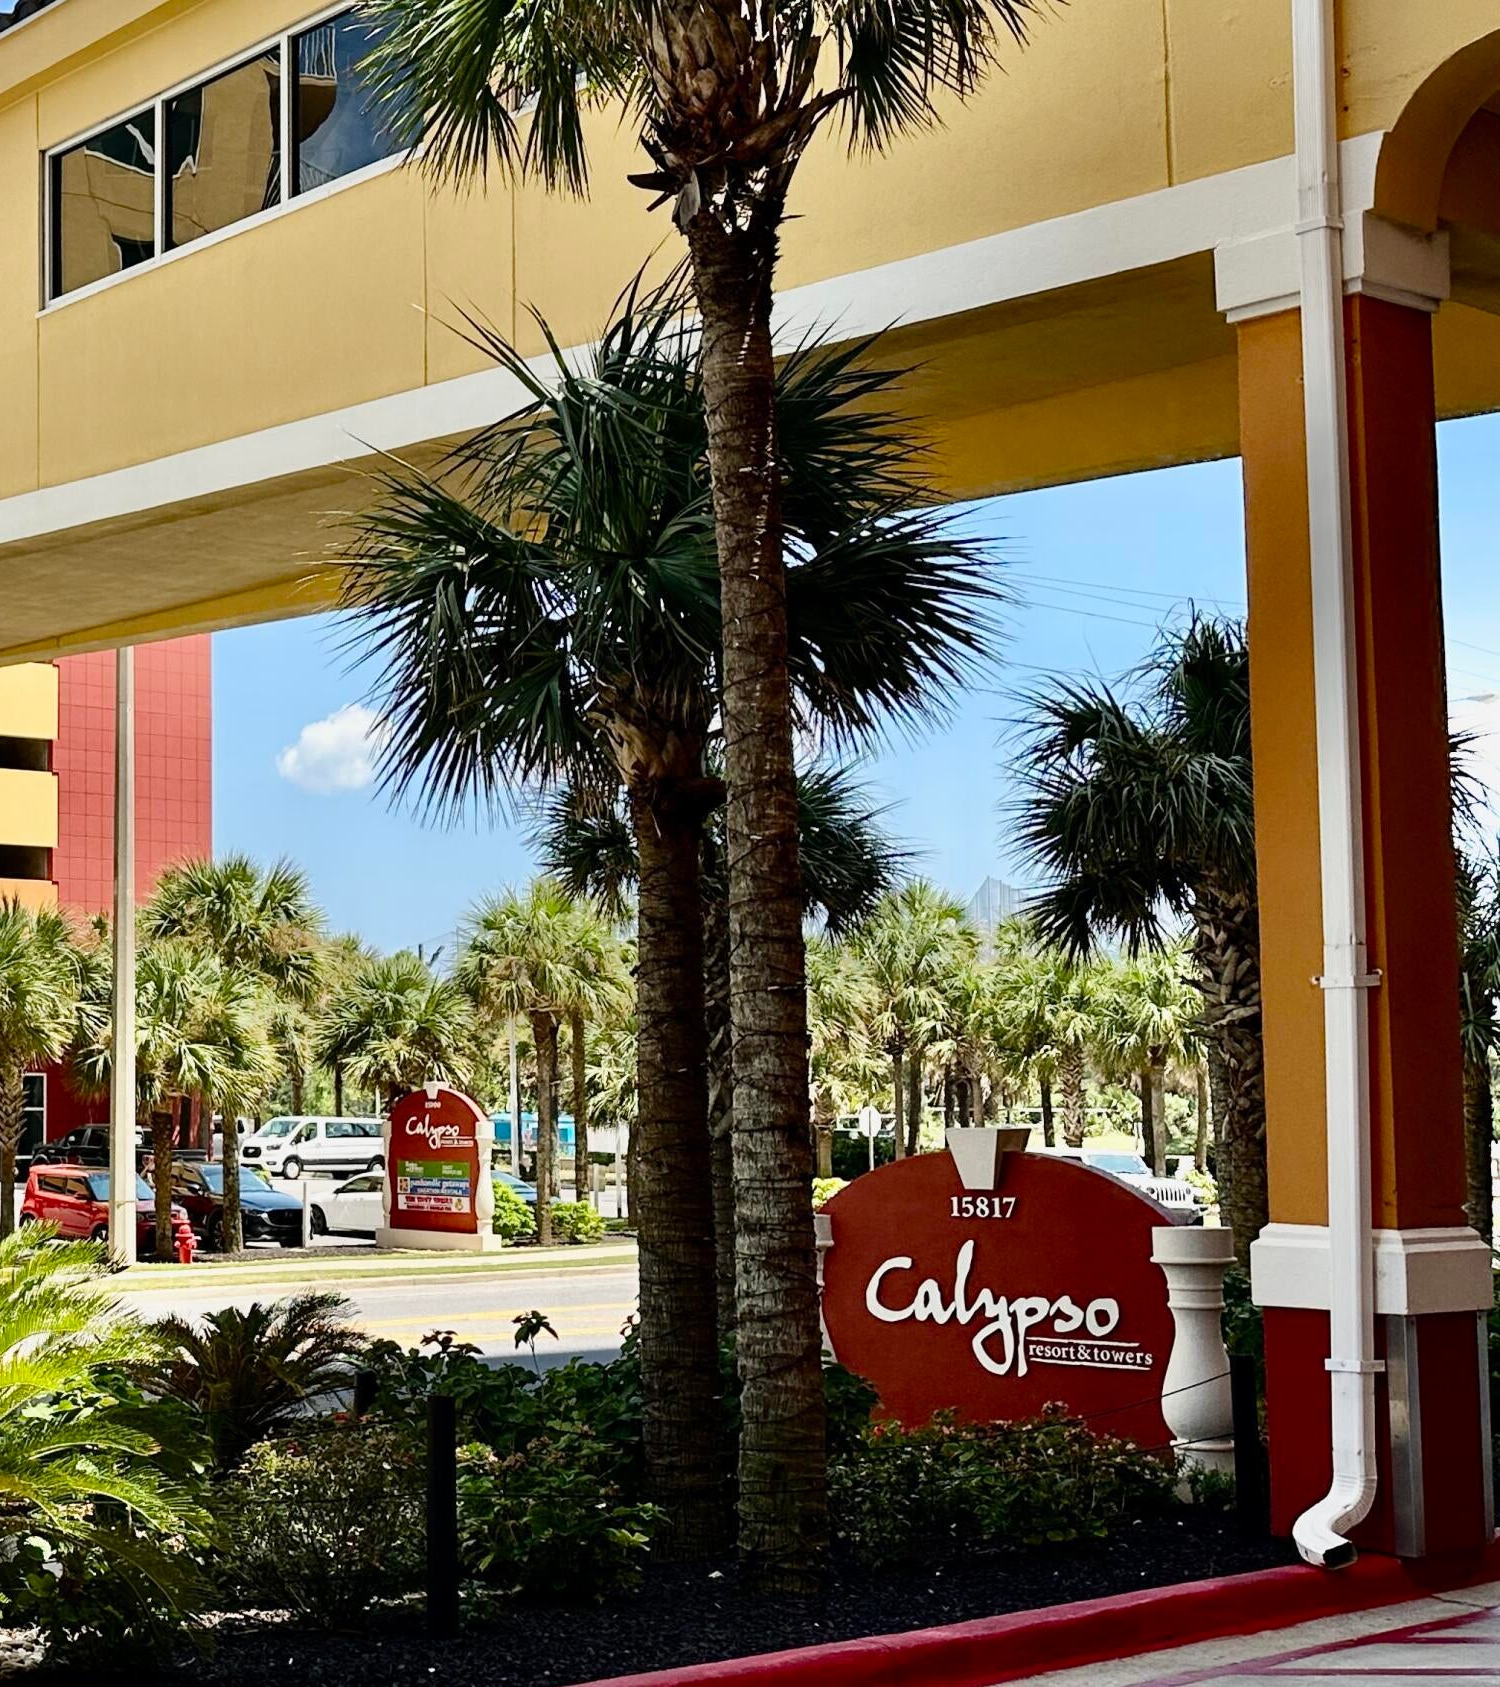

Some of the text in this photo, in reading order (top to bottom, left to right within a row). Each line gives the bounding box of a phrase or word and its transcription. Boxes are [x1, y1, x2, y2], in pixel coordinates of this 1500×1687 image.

[405, 1113, 460, 1150] Calypso
[950, 1196, 1016, 1219] 15817
[865, 1239, 1120, 1377] Calypso
